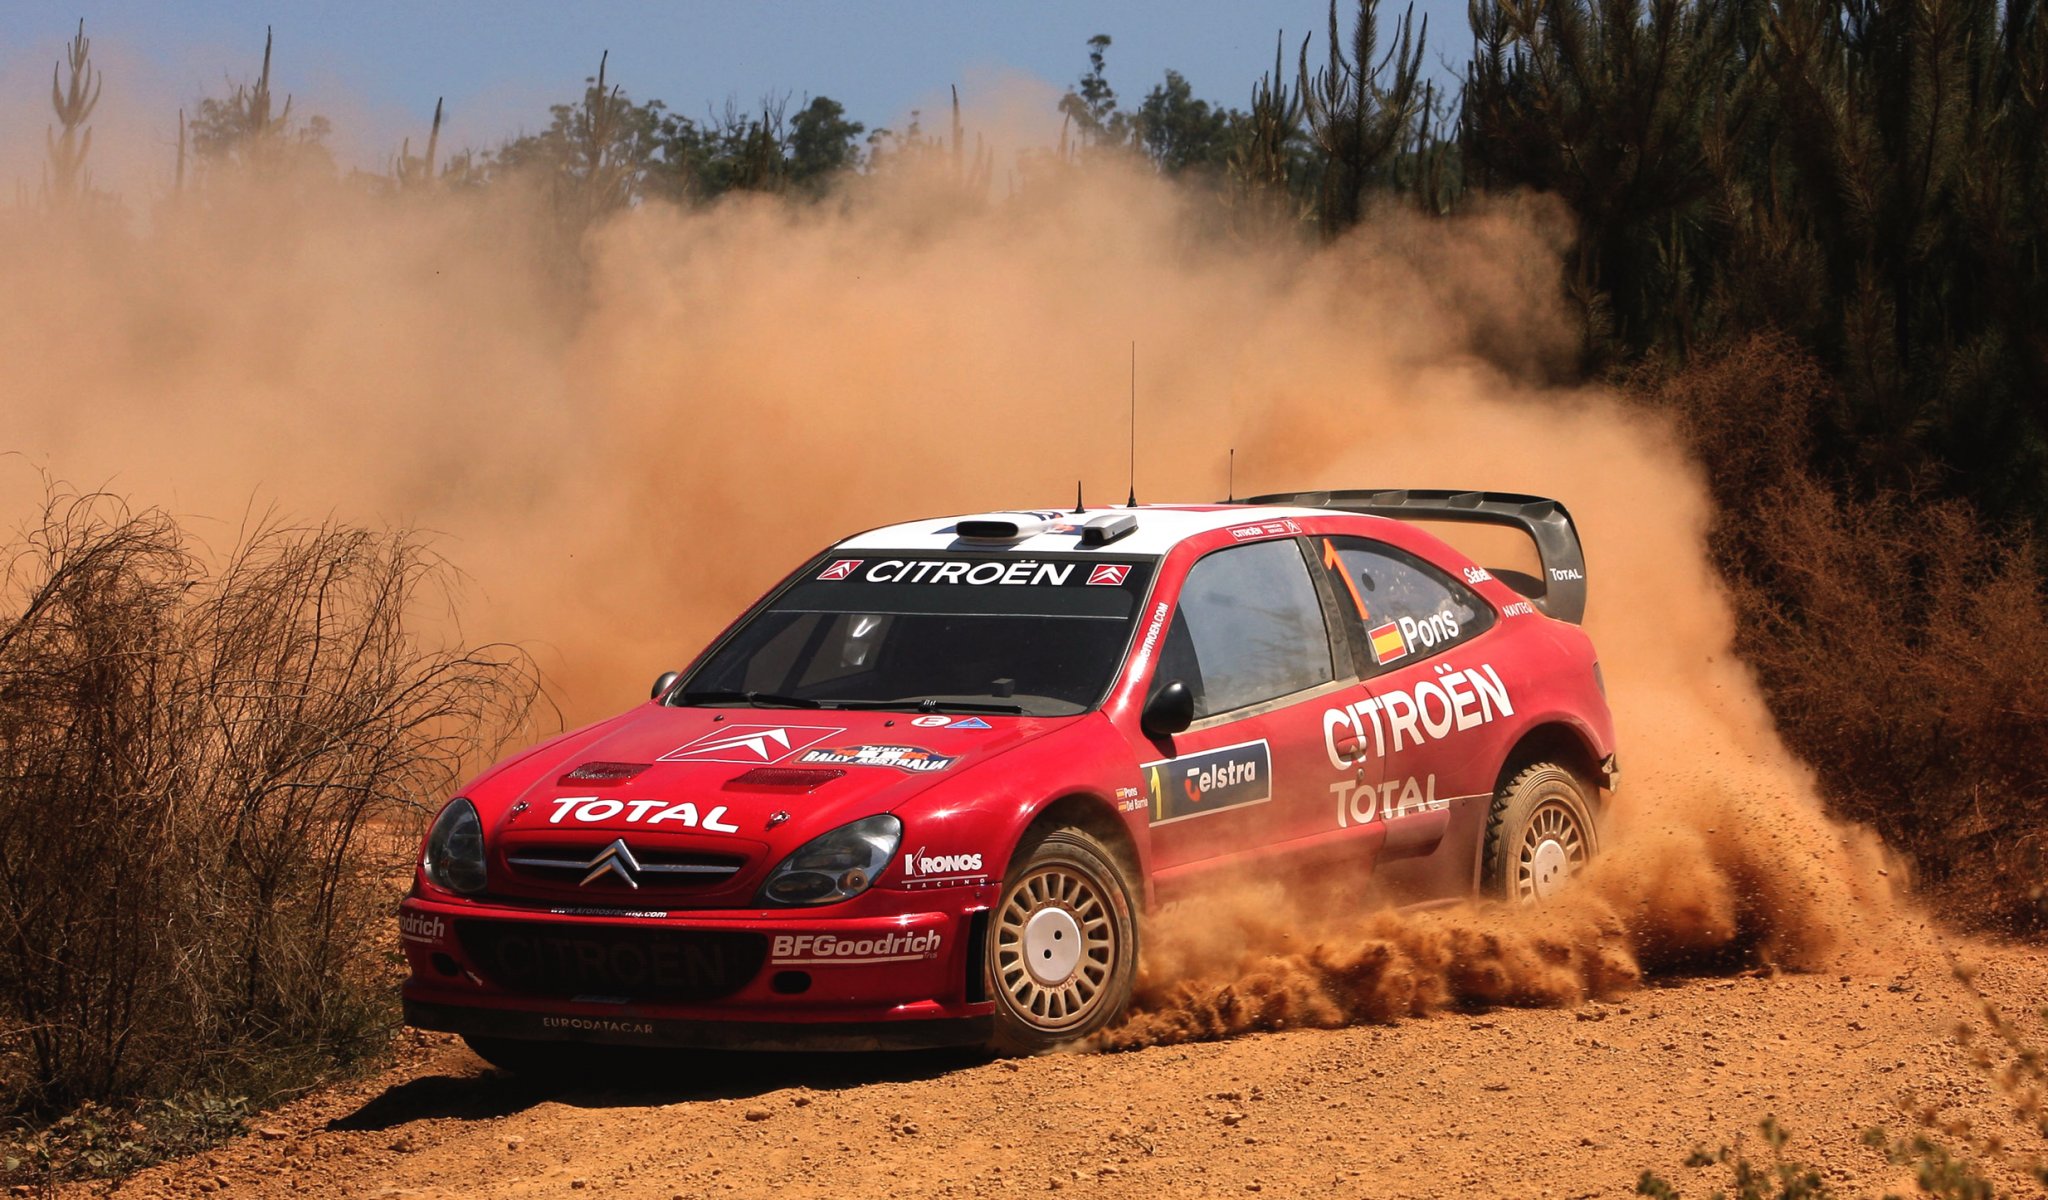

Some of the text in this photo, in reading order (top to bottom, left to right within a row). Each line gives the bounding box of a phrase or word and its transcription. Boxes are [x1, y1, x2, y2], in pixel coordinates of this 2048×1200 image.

[865, 559, 1075, 586] CITROËN
[1323, 538, 1370, 620] 1
[1550, 568, 1582, 581] TOTAL
[1398, 609, 1460, 654] Pons
[1323, 663, 1515, 771] CITROËN
[801, 750, 851, 763] RALLY
[855, 757, 948, 770] AUSTRALIA
[1150, 760, 1256, 820] 1 Telstra
[1329, 774, 1449, 828] TOTAL
[549, 796, 740, 833] TOTAL
[905, 846, 983, 877] KRONOS
[772, 929, 941, 957] BFGoodrich
[543, 1017, 653, 1034] EURODATACAR
